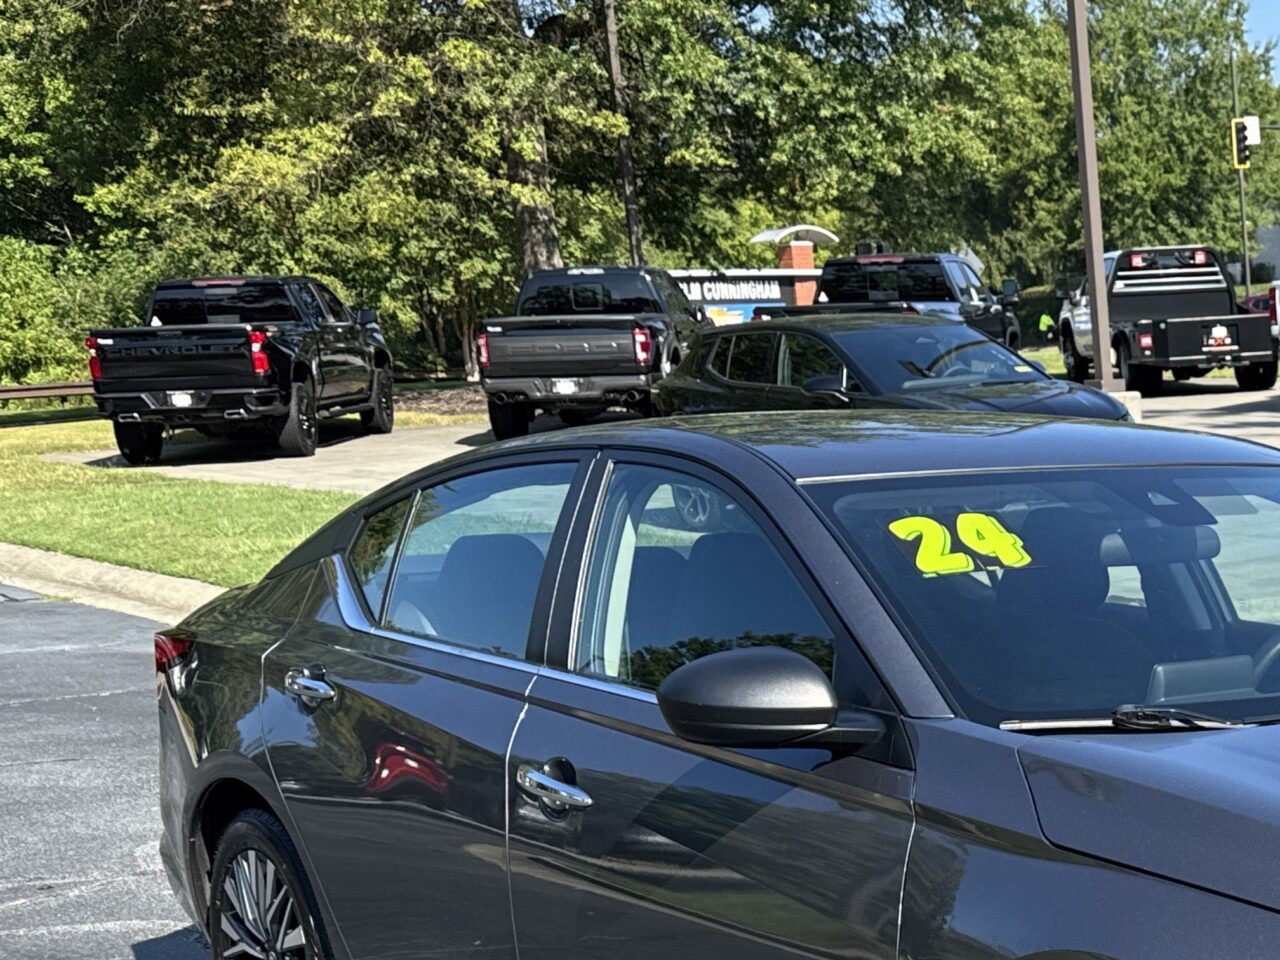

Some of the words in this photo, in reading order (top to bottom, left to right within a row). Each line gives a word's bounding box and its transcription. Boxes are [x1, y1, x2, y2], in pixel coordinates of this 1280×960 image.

[703, 281, 781, 300] CUNNINGHAM
[107, 344, 239, 357] CHEVROLET
[888, 513, 1032, 577] 24
